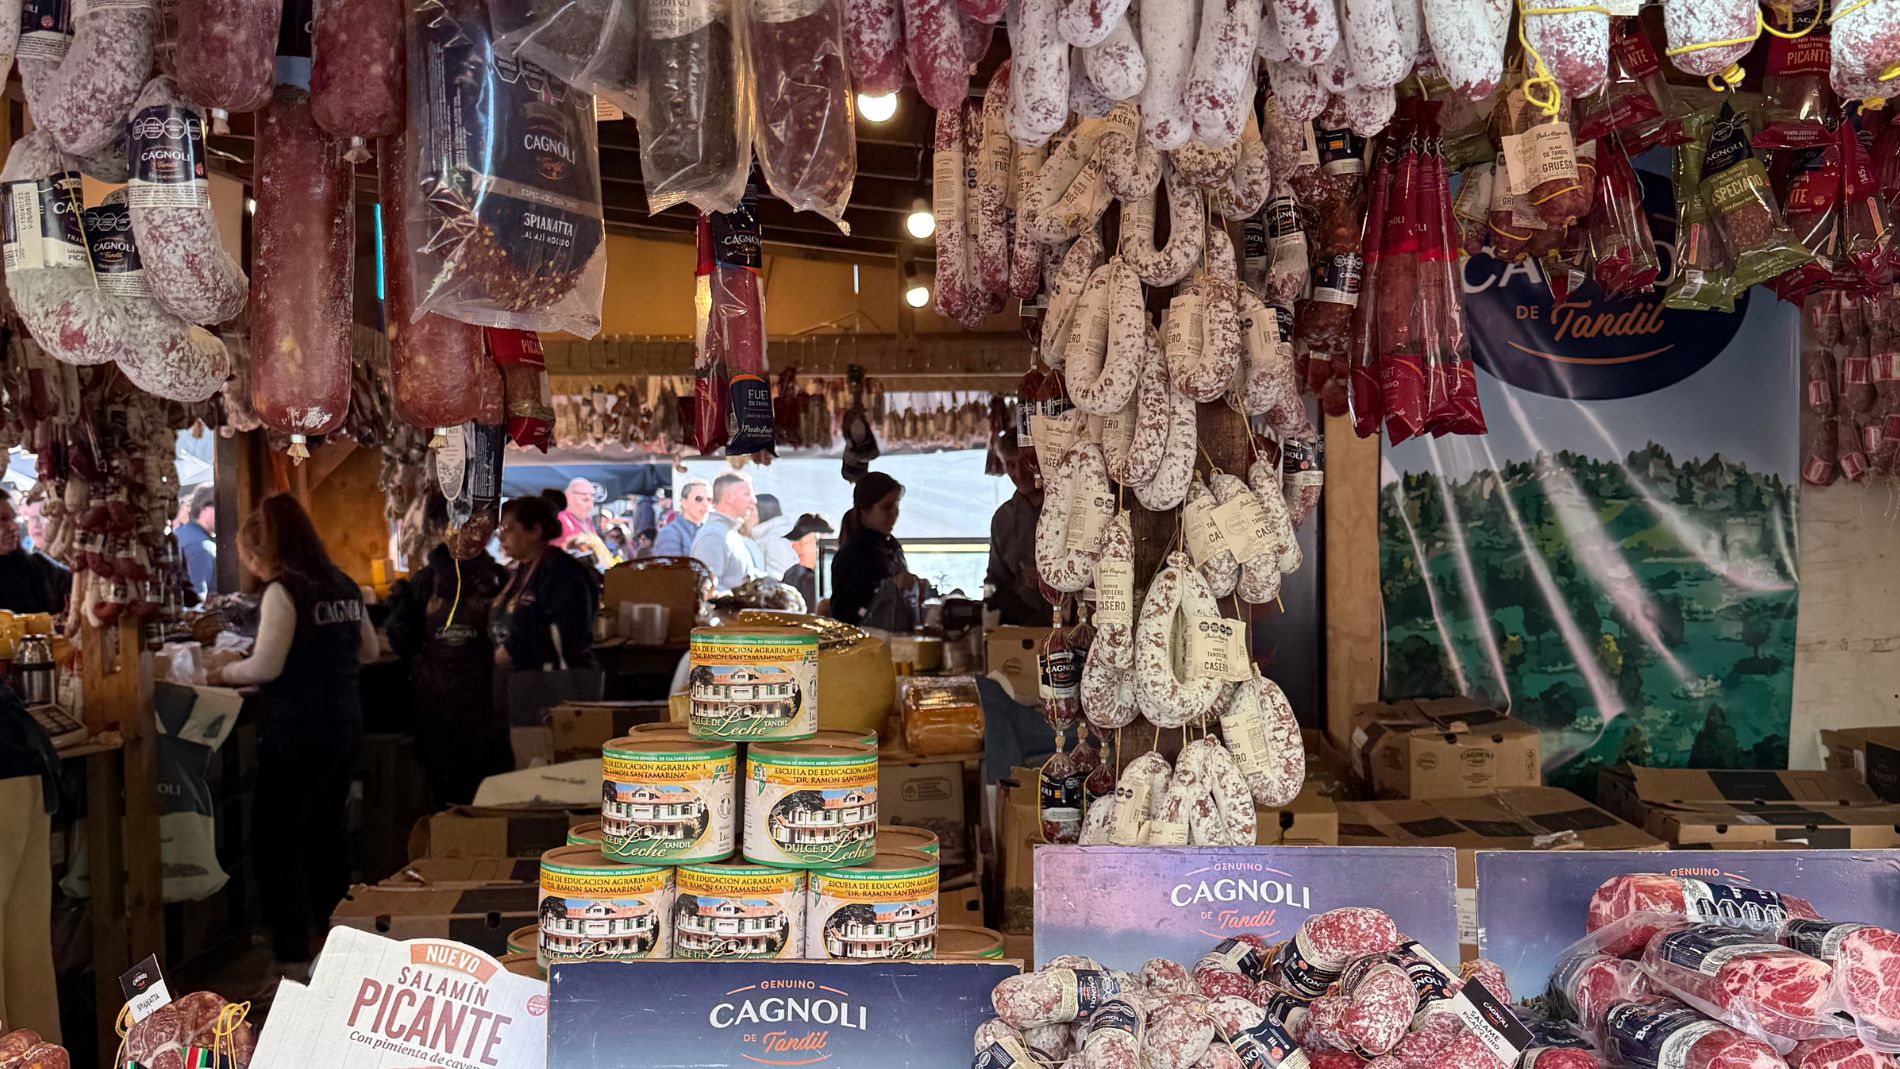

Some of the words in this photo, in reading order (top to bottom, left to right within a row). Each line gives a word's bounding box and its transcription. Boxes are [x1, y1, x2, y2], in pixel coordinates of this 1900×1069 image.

[1787, 50, 1830, 66] PICANTE
[1106, 113, 1136, 131] CASERO
[141, 151, 191, 161] CAGNOLI
[524, 134, 575, 165] CAGNOLI
[1542, 160, 1573, 173] GRUESO
[524, 213, 573, 237] SPIANATTA
[93, 241, 135, 253] CAGNOLI
[1516, 304, 1539, 320] DE
[1551, 299, 1666, 342] Tandil
[710, 646, 752, 654] EDUCACION
[1204, 661, 1229, 672] CASERO
[700, 704, 767, 737] Leche
[712, 718, 721, 726] DE
[614, 761, 654, 770] EDUCACION
[775, 767, 806, 776] ESCUELA
[820, 767, 861, 776] EDUCACION
[811, 776, 840, 784] RAMON
[602, 824, 667, 857] Leche
[664, 841, 691, 849] TANDIL
[803, 827, 866, 864] Leche
[785, 843, 819, 853] DULCE
[821, 844, 834, 853] DE
[1214, 863, 1263, 871] GENUINO
[1670, 868, 1720, 877] GENUINO
[564, 876, 610, 886] EDUCACION
[611, 877, 646, 885] AGRARIA
[690, 881, 713, 891] RAMON
[696, 875, 739, 885] EDUCACION
[829, 880, 858, 889] ESCUELA
[872, 881, 916, 889] EDUCACION
[556, 884, 582, 892] RAMON
[863, 889, 892, 897] RAMON
[1170, 878, 1311, 910] CAGNOLI
[1200, 912, 1213, 920] DE
[1218, 909, 1276, 931] Tandil
[425, 945, 480, 974] NUEVO
[397, 966, 490, 1007] SALAMÍN
[761, 980, 816, 990] GENUINO
[1087, 975, 1096, 1009] CAGNOLI
[709, 997, 867, 1031] CAGNOLI
[1483, 1001, 1509, 1029] CAGNOLI
[347, 977, 513, 1067] PICANTE
[1470, 1010, 1501, 1042] SALAME
[1462, 1011, 1485, 1035] PICADO
[1484, 1034, 1500, 1050] FINO
[350, 1030, 372, 1046] Con
[372, 1035, 428, 1063] pimienta
[429, 1051, 445, 1064] de
[743, 1033, 757, 1042] DE
[763, 1030, 829, 1054] Tandil
